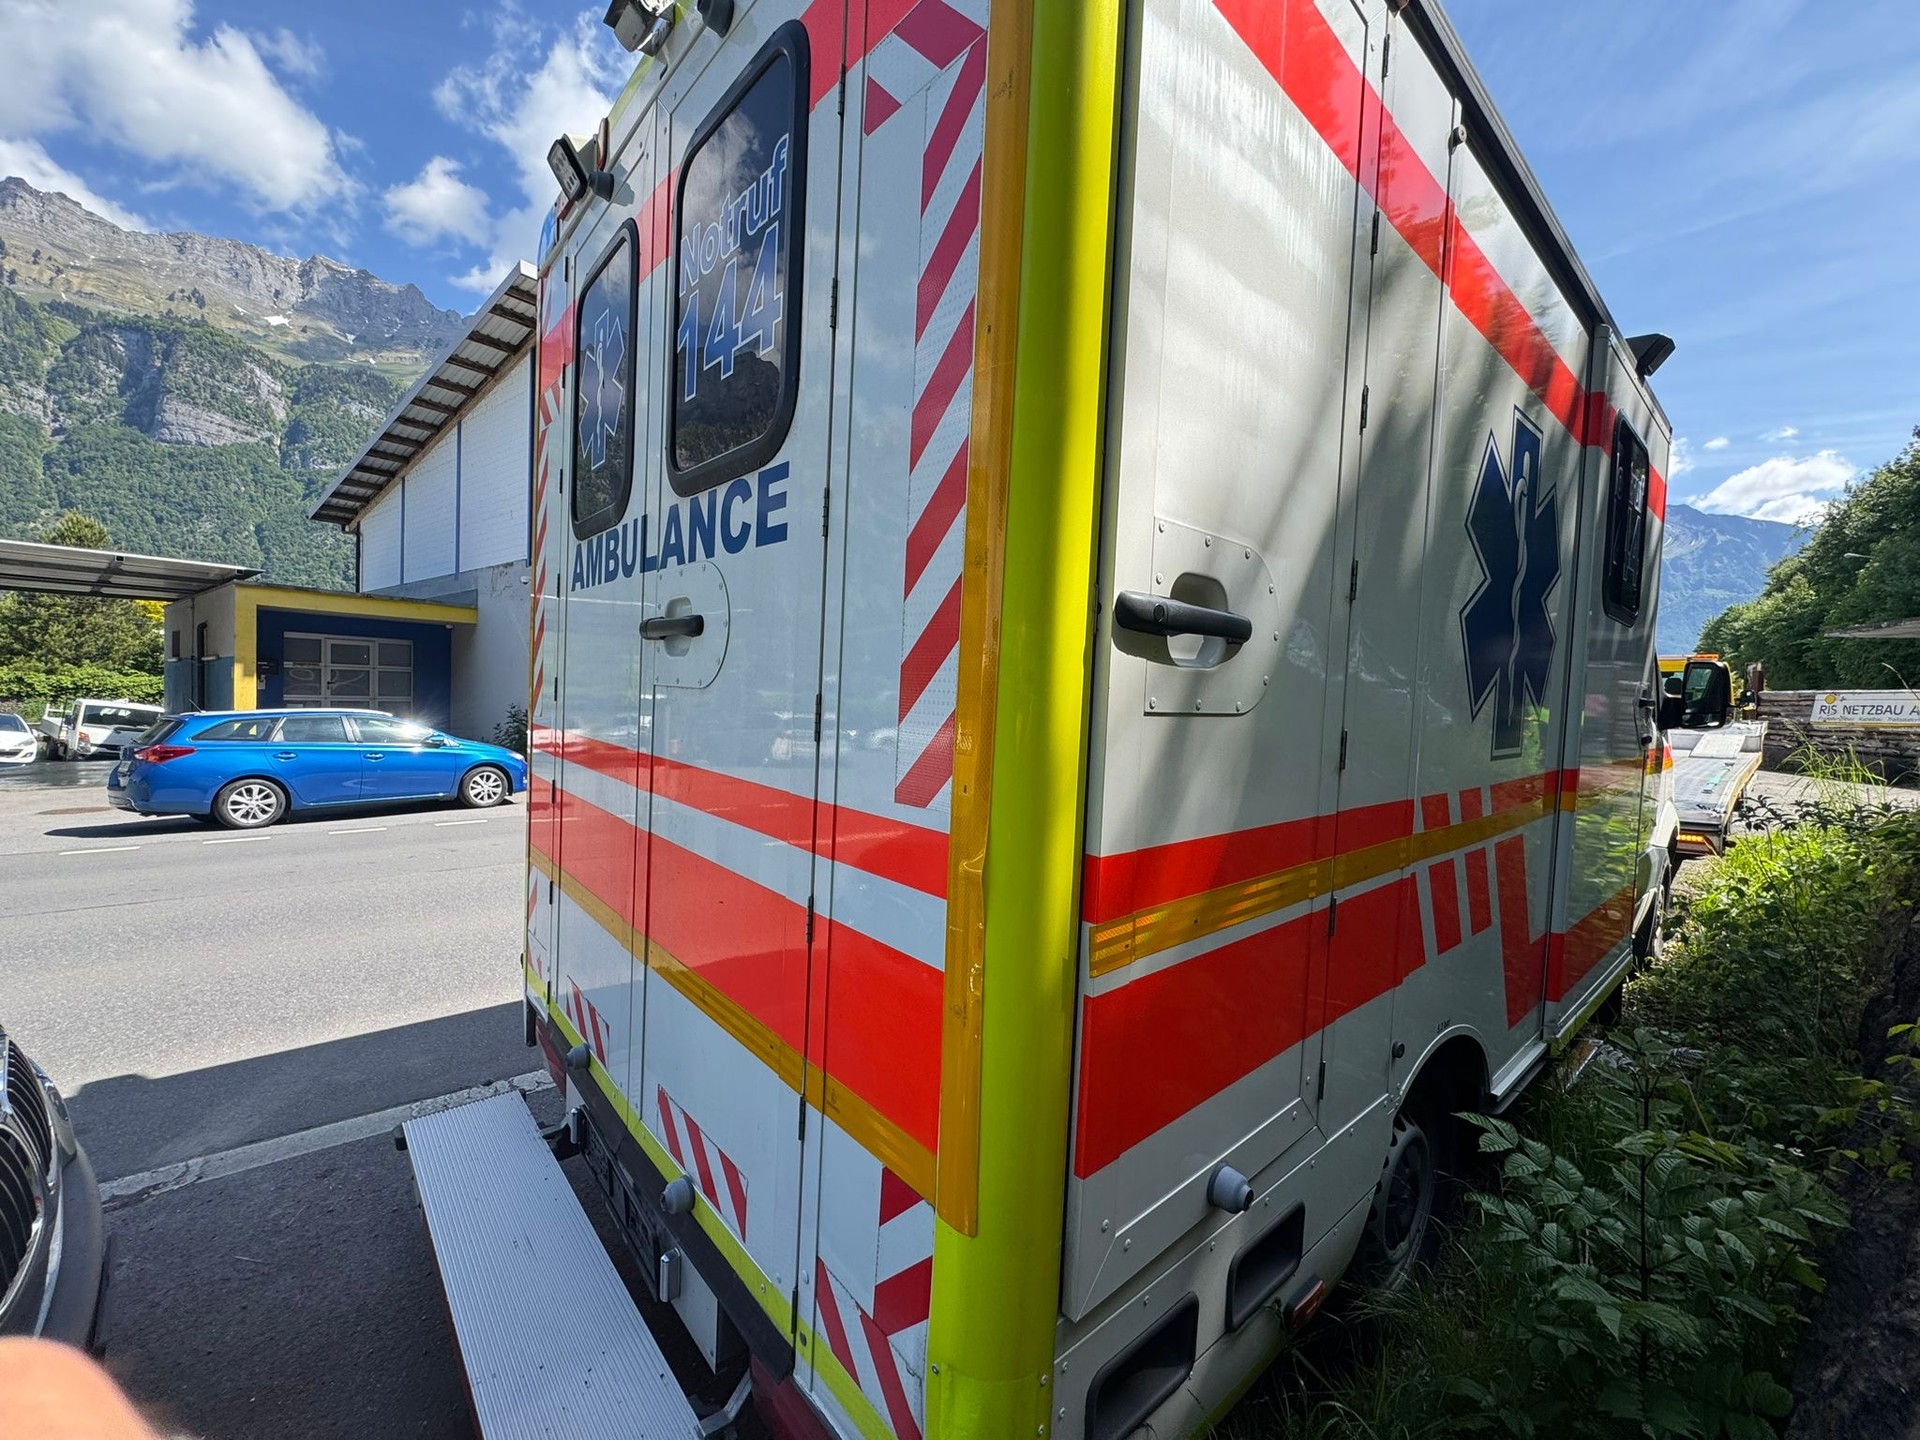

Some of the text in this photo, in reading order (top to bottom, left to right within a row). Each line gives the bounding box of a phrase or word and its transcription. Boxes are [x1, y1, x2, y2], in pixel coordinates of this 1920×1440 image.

[679, 133, 789, 298] Notruf
[677, 220, 783, 402] 144
[571, 460, 790, 592] AMBULANCE
[1818, 704, 1837, 715] RIS
[1842, 704, 1905, 716] NETZBAU
